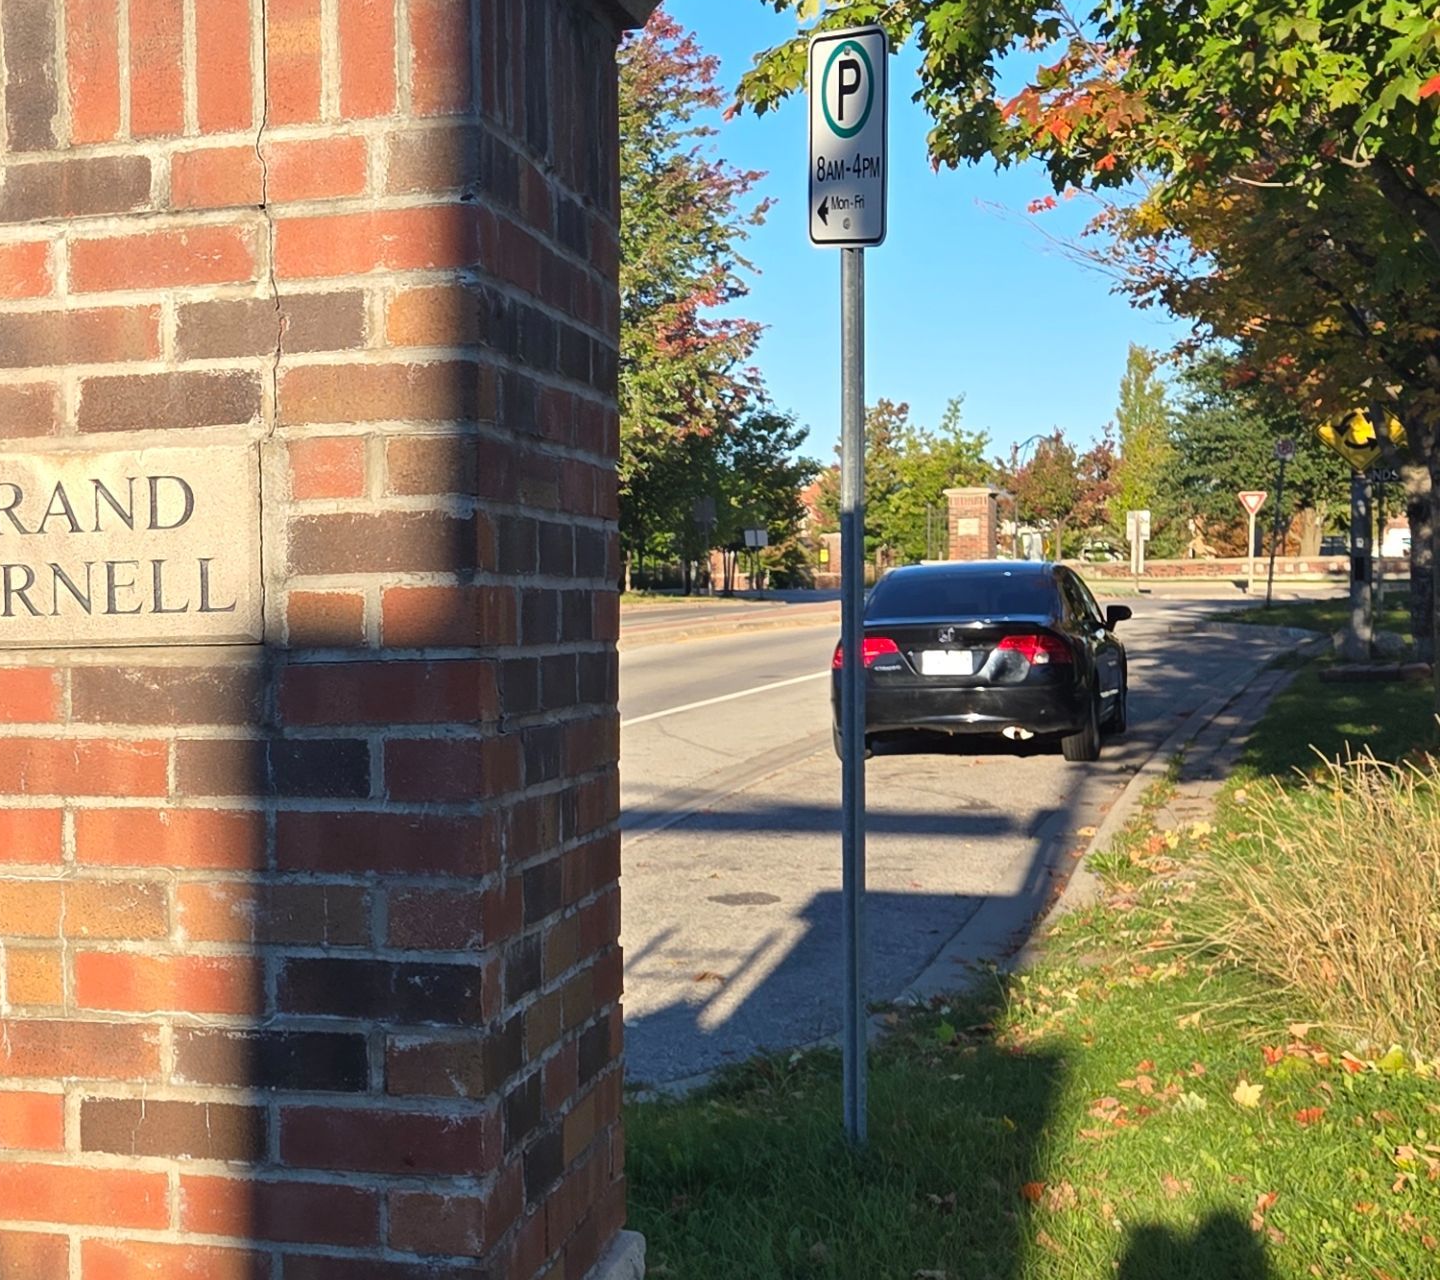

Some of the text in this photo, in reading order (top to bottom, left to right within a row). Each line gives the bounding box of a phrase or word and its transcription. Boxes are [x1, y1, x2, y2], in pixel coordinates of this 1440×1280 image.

[838, 59, 861, 121] P
[816, 153, 880, 182] 8AM-4PM
[1367, 469, 1399, 481] NDS
